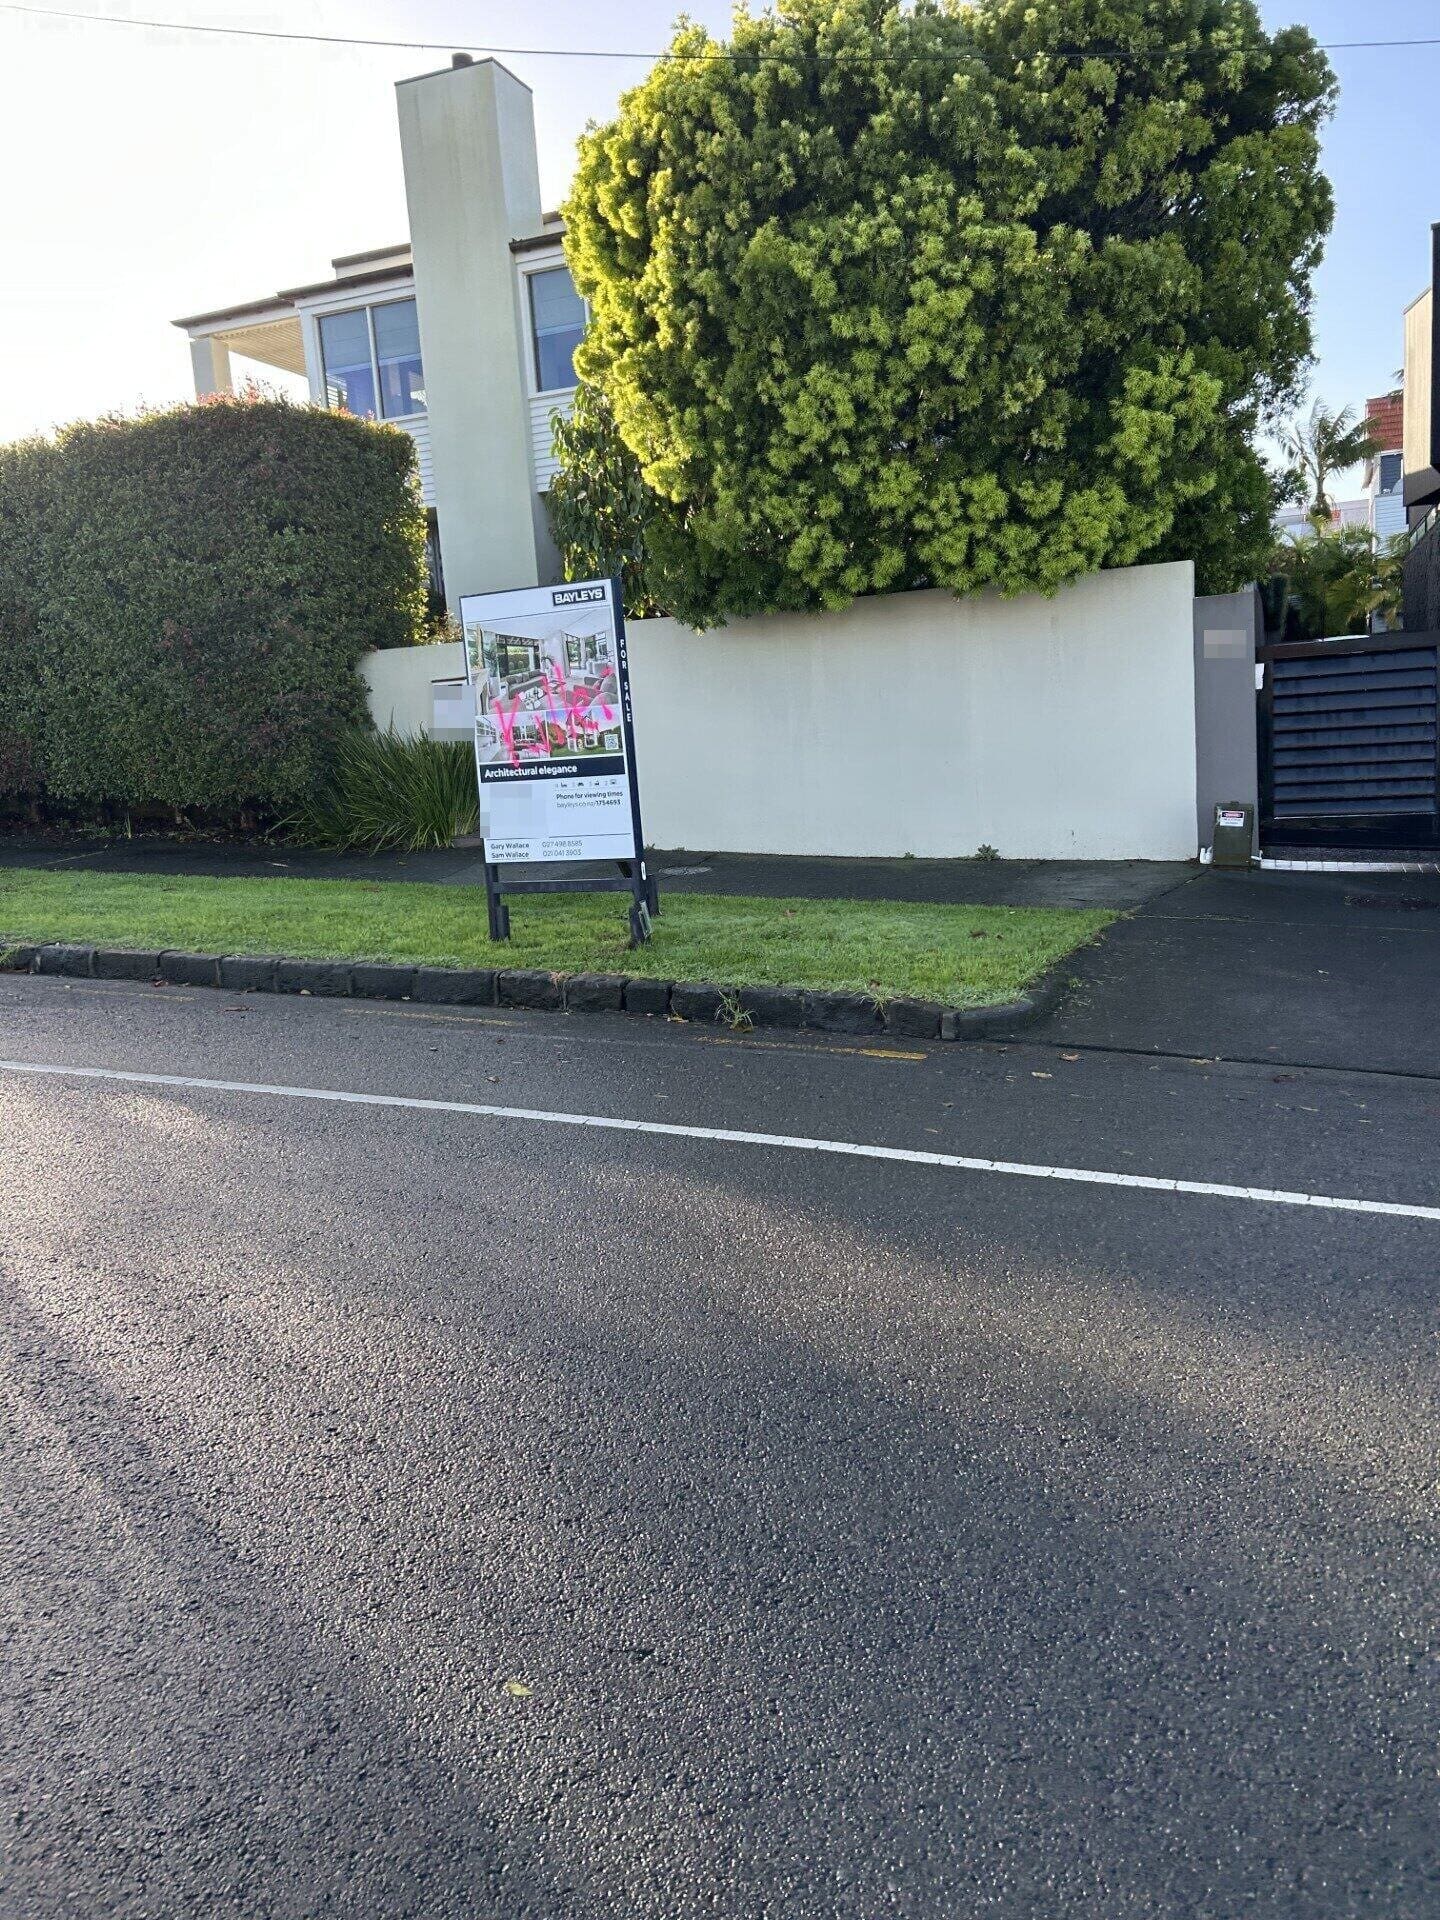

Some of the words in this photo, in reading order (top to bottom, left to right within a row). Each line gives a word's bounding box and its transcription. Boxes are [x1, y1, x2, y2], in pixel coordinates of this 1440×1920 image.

[554, 588, 603, 604] BAYLEYS
[619, 639, 628, 670] FOR
[623, 681, 632, 723] SALE
[485, 766, 538, 779] Architectural
[539, 765, 578, 777] elegance
[584, 791, 606, 799] viewing
[505, 841, 530, 849] Wallace
